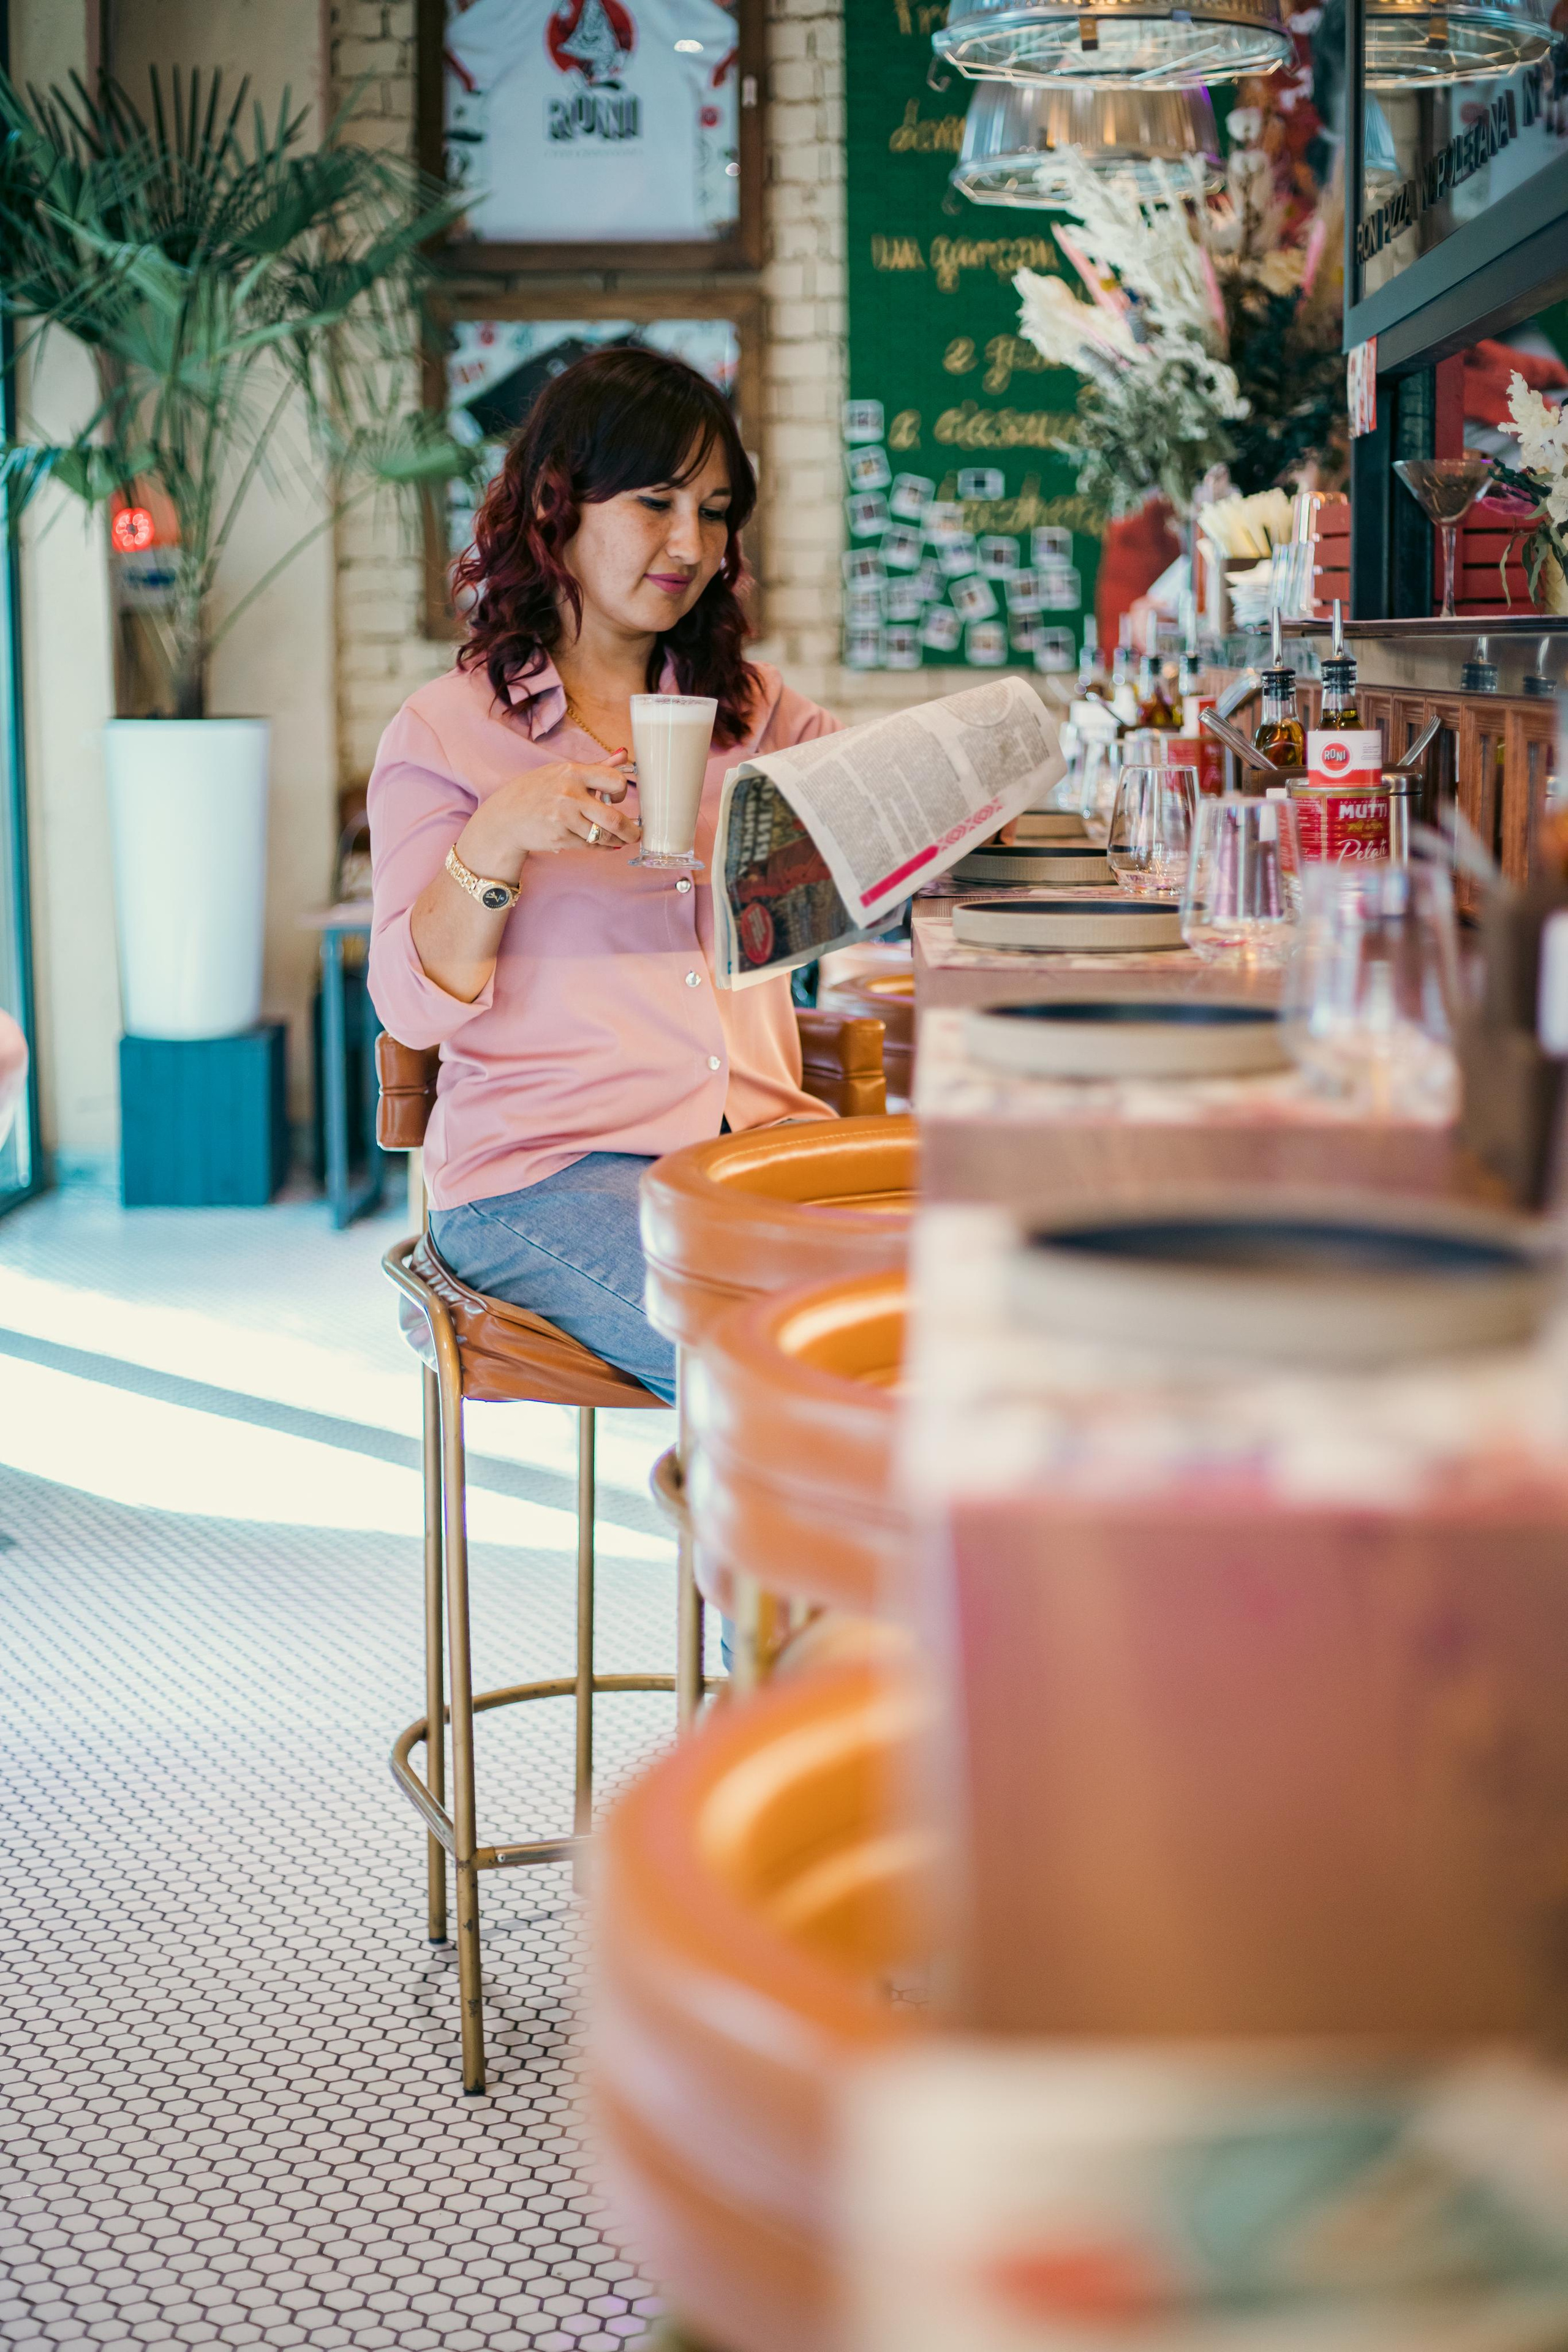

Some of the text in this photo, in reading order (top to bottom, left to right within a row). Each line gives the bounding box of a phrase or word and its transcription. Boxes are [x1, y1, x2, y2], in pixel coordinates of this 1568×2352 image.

[548, 94, 641, 138] RONI
[1324, 748, 1346, 762] RONI
[1339, 803, 1387, 818] MUTTI
[1337, 839, 1387, 867] Pelati
